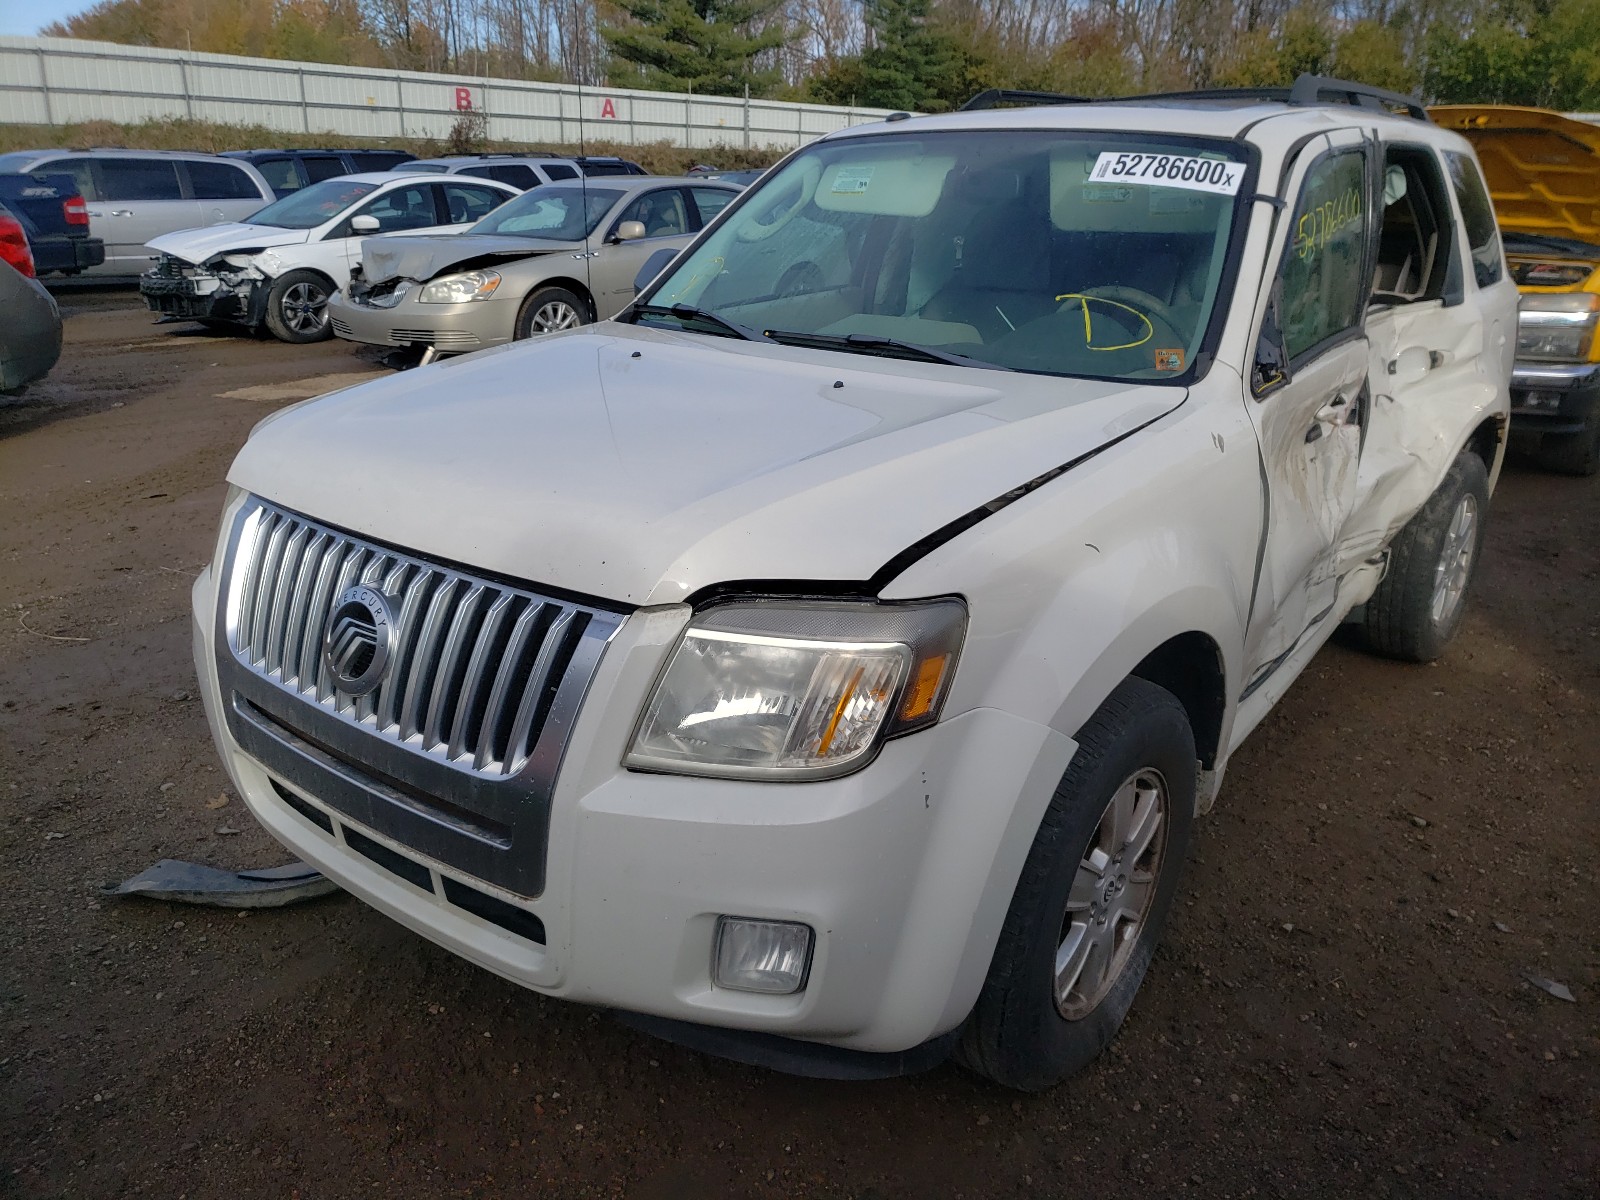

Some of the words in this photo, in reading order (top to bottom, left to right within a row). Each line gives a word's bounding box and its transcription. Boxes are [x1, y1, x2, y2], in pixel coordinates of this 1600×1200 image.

[455, 87, 473, 109] B
[601, 98, 616, 118] A
[334, 590, 387, 627] MERCURY
